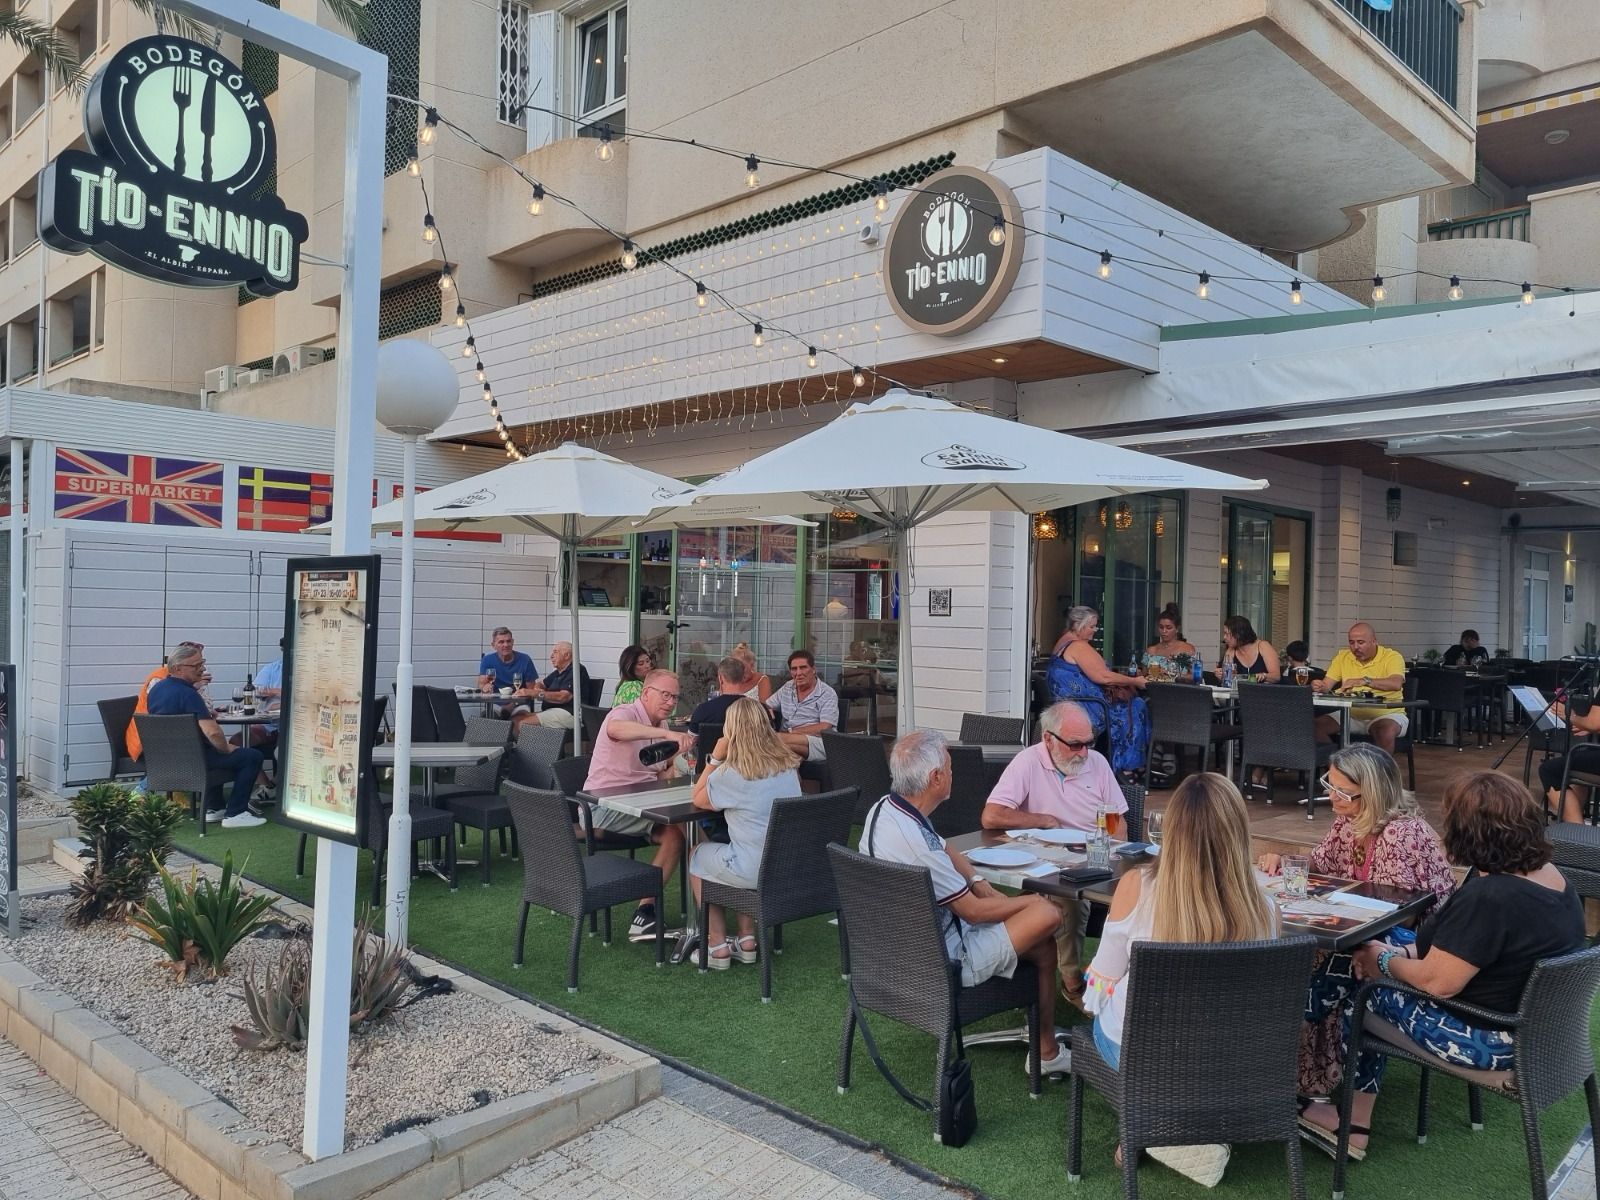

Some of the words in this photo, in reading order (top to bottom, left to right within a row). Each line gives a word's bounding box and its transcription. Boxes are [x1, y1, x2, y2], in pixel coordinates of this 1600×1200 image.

[129, 45, 260, 112] BODEGÓN
[161, 256, 188, 269] ALBIR
[68, 477, 213, 501] SUPERMARKET
